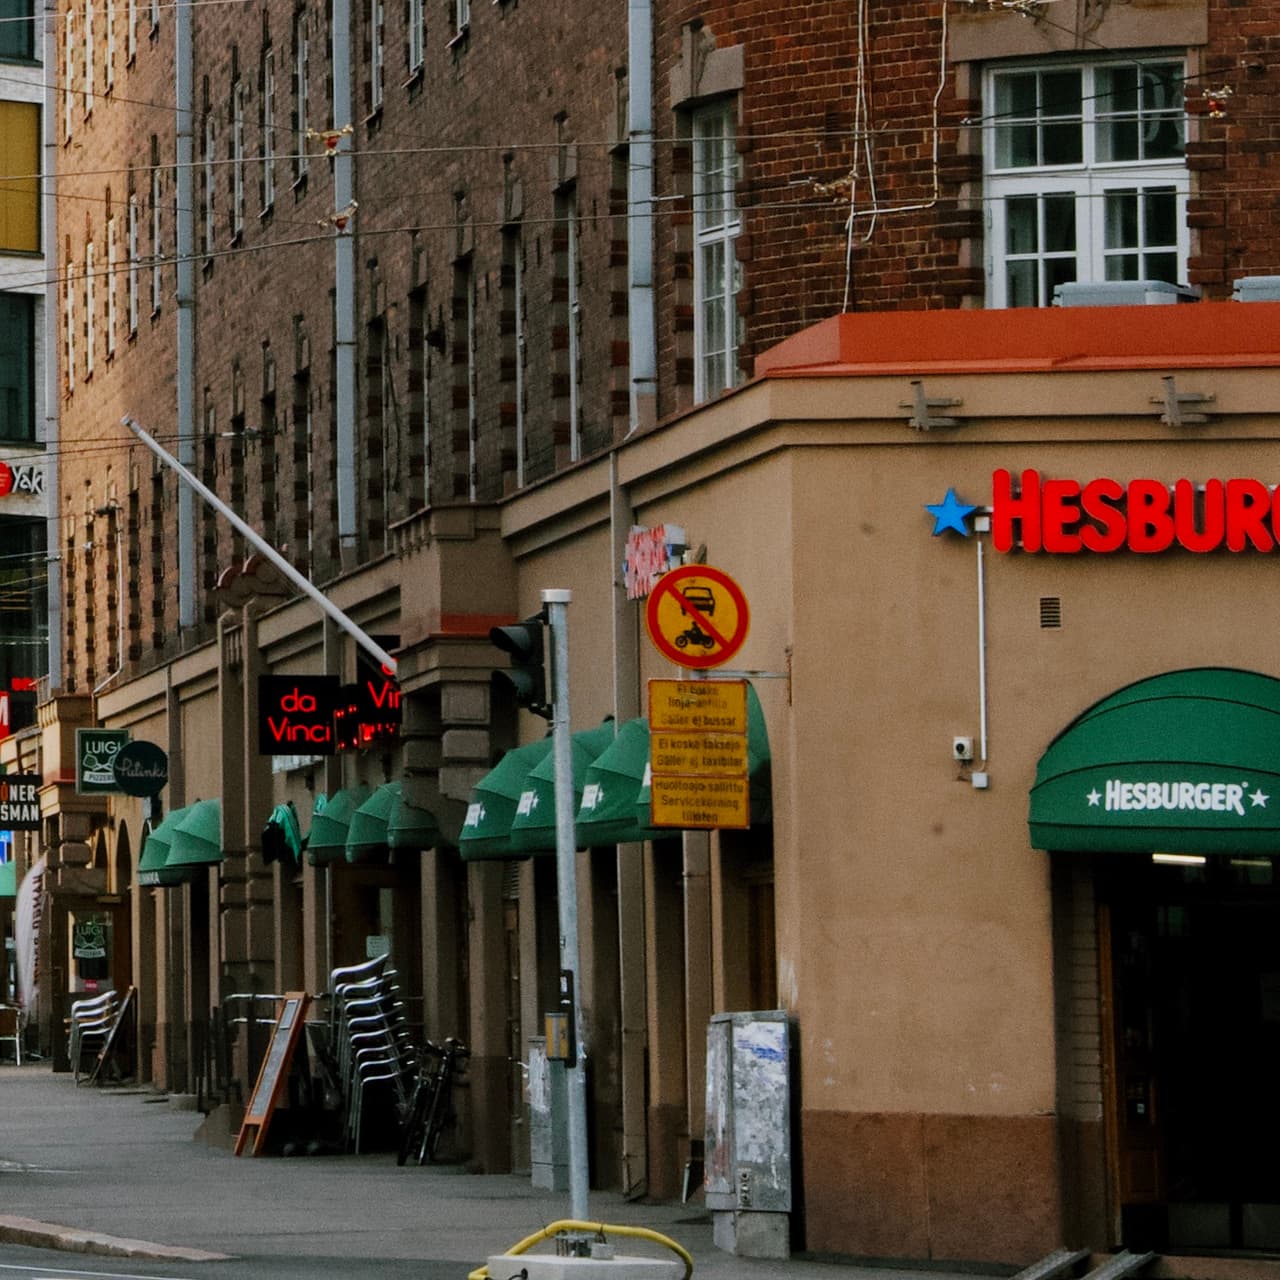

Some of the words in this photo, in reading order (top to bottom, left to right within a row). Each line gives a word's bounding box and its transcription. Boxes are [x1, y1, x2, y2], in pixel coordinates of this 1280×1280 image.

[993, 469, 1280, 552] HESBUR
[280, 687, 317, 712] da
[267, 716, 331, 743] Vinci
[704, 715, 736, 727] bussar
[1105, 779, 1246, 817] HESBURGER
